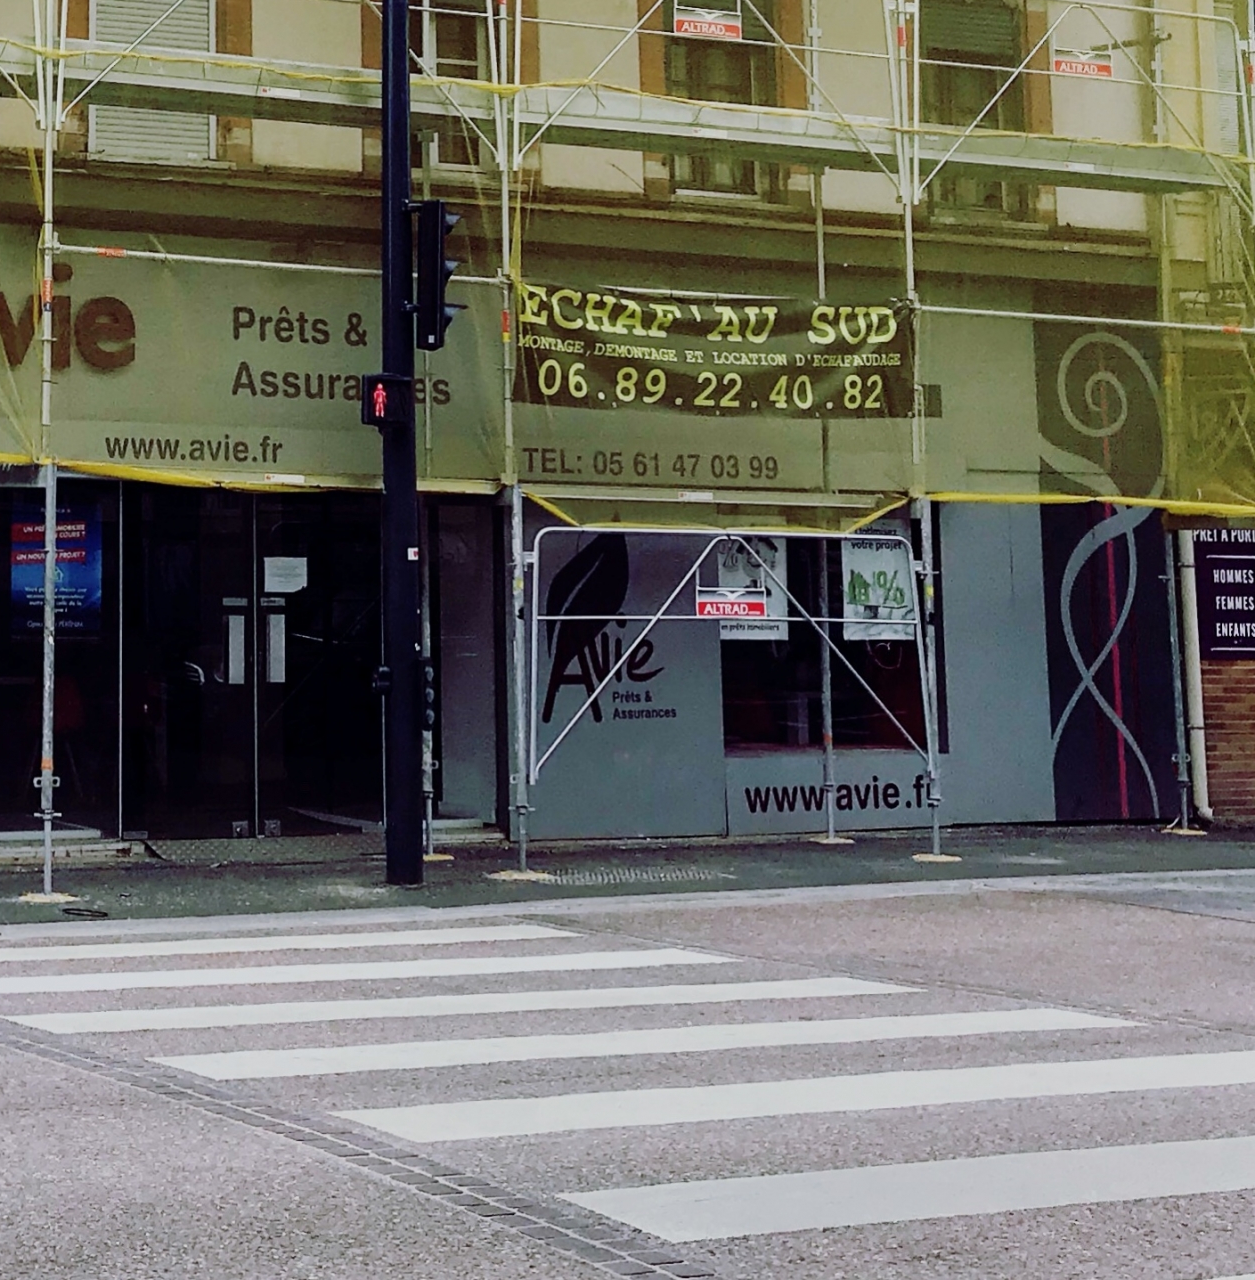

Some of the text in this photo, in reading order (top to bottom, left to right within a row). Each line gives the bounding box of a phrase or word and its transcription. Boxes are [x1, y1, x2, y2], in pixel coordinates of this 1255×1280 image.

[681, 21, 725, 35] ALTRAD
[1060, 62, 1098, 75] ALTRAD
[232, 305, 367, 347] Prêts &
[807, 305, 898, 345] SUD
[685, 350, 705, 363] ET
[712, 351, 788, 367] LOCATION
[796, 352, 901, 368] D'ECHAFAUDAGE
[232, 361, 451, 406] Assuraes
[105, 434, 283, 464] www.avie.fr
[523, 447, 778, 481] TEL: 05 61 47 03 99
[850, 540, 902, 552] votre projet
[1212, 569, 1254, 584] HOMMES
[704, 603, 748, 615] ALTRAD
[1215, 596, 1255, 611] FEMMES
[1215, 622, 1255, 638] ENFANTS
[542, 611, 666, 724] Avie
[612, 690, 653, 703] Prêts &
[612, 707, 677, 720] Assurances
